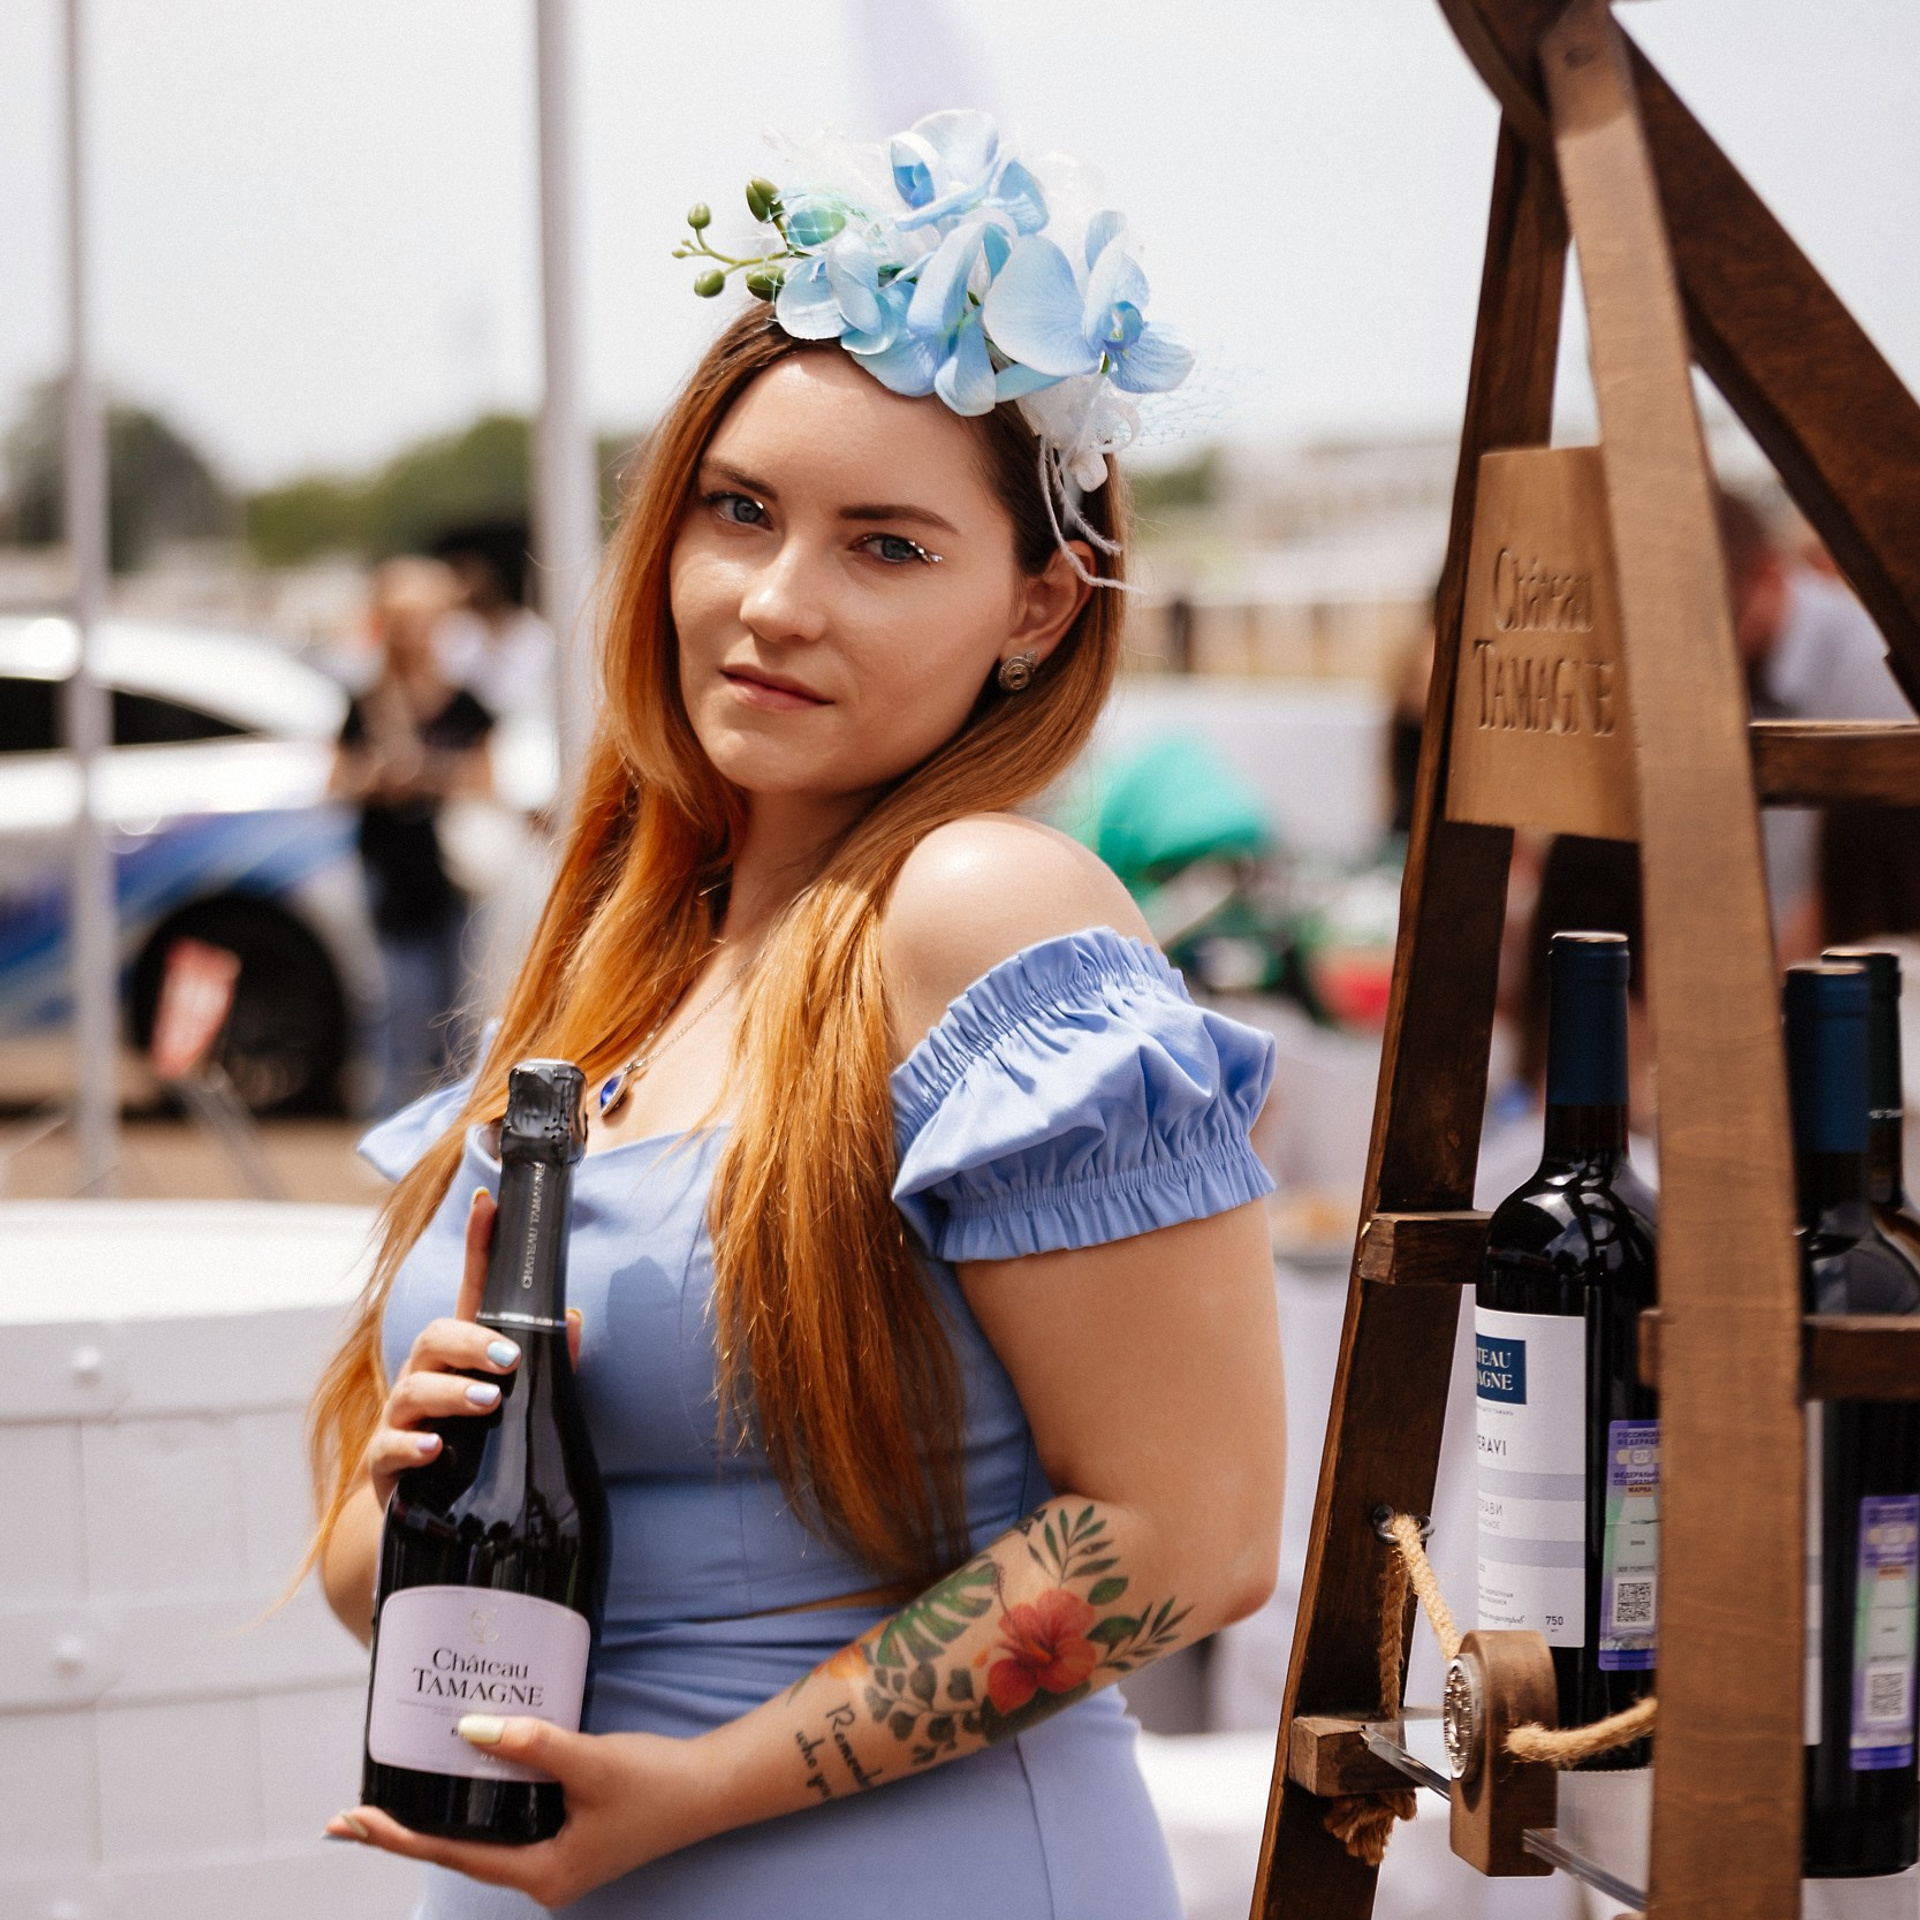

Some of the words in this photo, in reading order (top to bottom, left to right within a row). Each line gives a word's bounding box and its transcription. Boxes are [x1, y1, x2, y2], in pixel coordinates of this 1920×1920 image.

[1473, 639, 1615, 737] TAMAGNE
[1545, 1615, 1564, 1626] 750
[432, 1648, 529, 1679] Château
[412, 1667, 545, 1708] TAMAGNE
